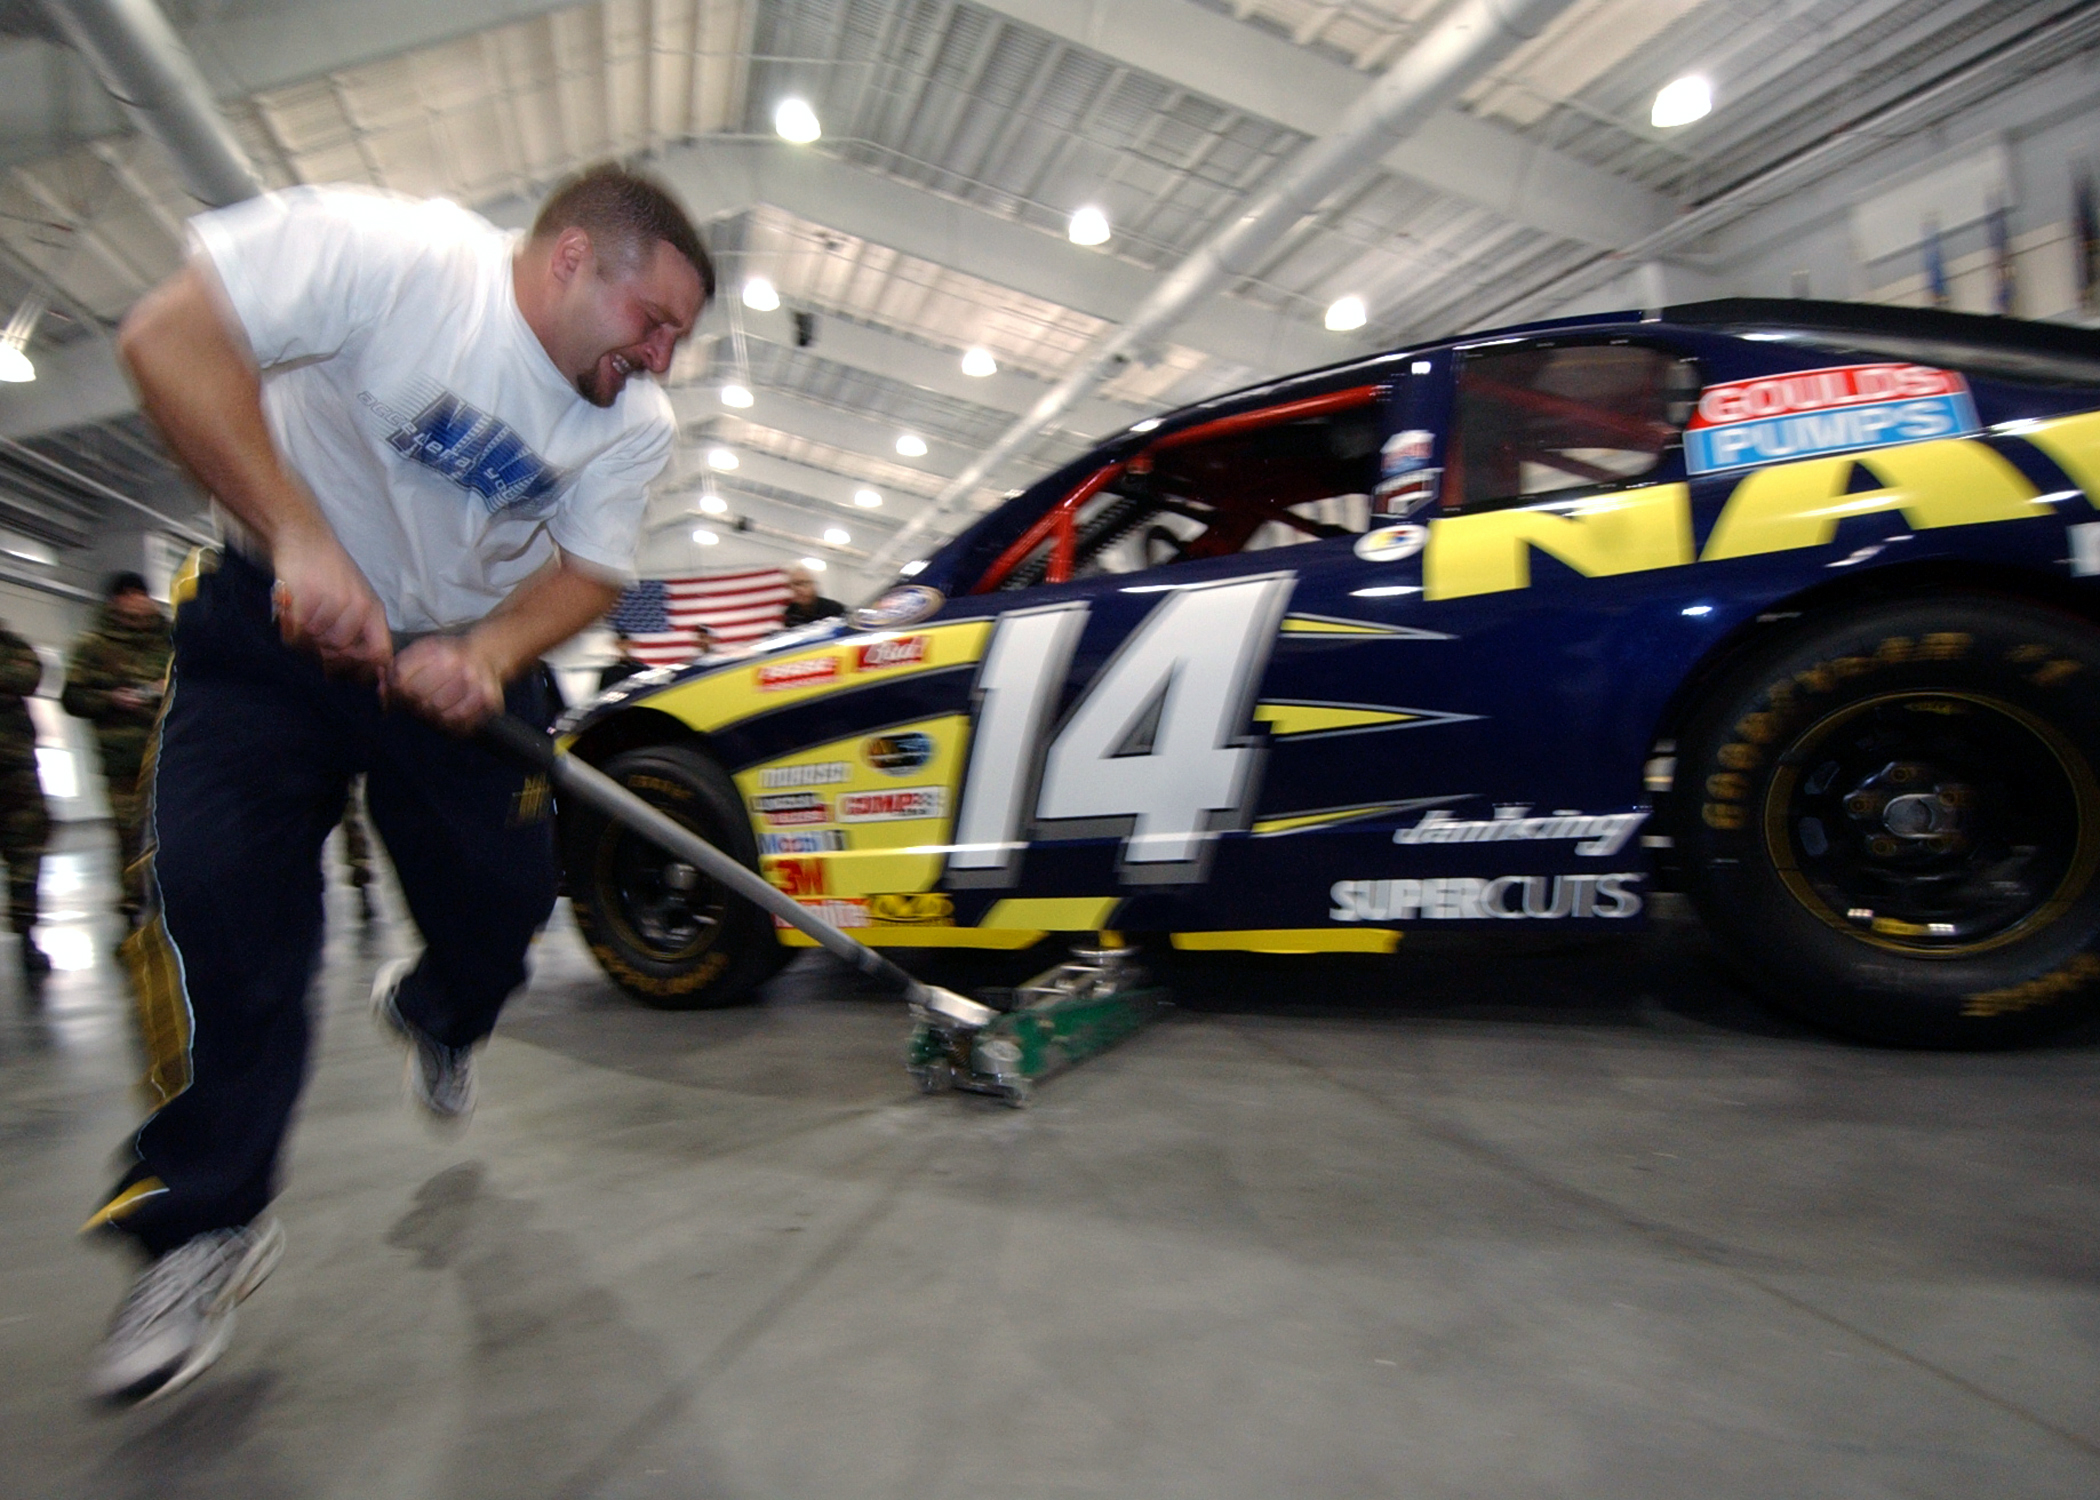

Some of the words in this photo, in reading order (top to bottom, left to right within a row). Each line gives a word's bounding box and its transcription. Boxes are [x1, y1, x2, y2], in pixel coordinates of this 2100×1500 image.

[1699, 366, 1952, 423] GOULDS
[1710, 401, 1952, 465] PUMPS
[944, 574, 1288, 886] 14
[1329, 873, 1645, 922] SUPERCUTS
